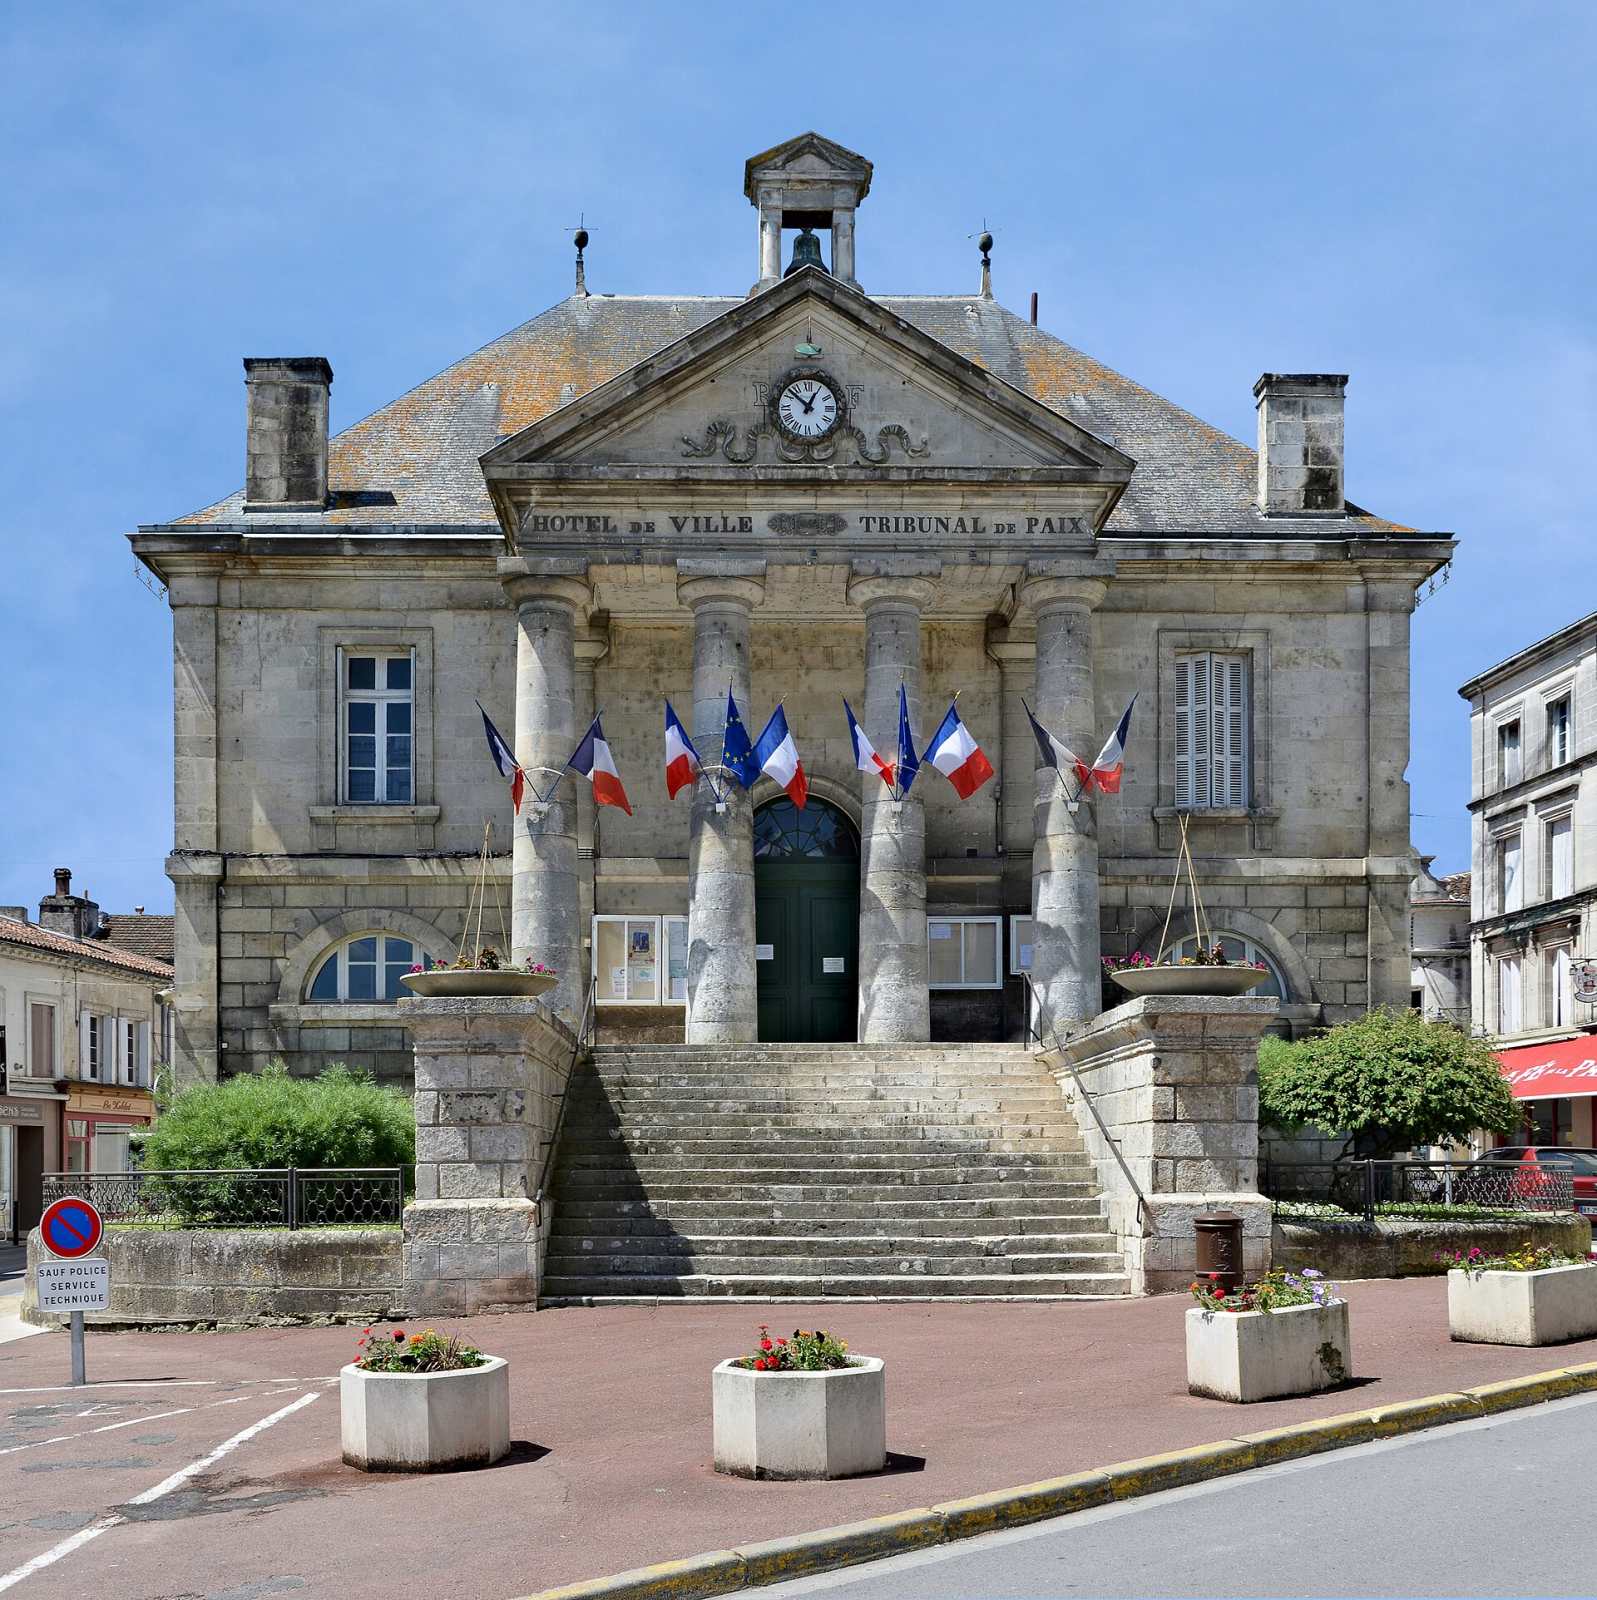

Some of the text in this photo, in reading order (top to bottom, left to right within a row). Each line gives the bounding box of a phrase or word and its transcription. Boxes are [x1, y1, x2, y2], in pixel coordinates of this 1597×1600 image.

[752, 382, 865, 410] R F
[532, 515, 1084, 534] HOTEL DE VILLE TRIBUNAL DE PAIX
[39, 1266, 107, 1278] SAUF POLICE
[51, 1280, 97, 1291] SERVICE
[44, 1293, 105, 1305] TECHNIQUE
